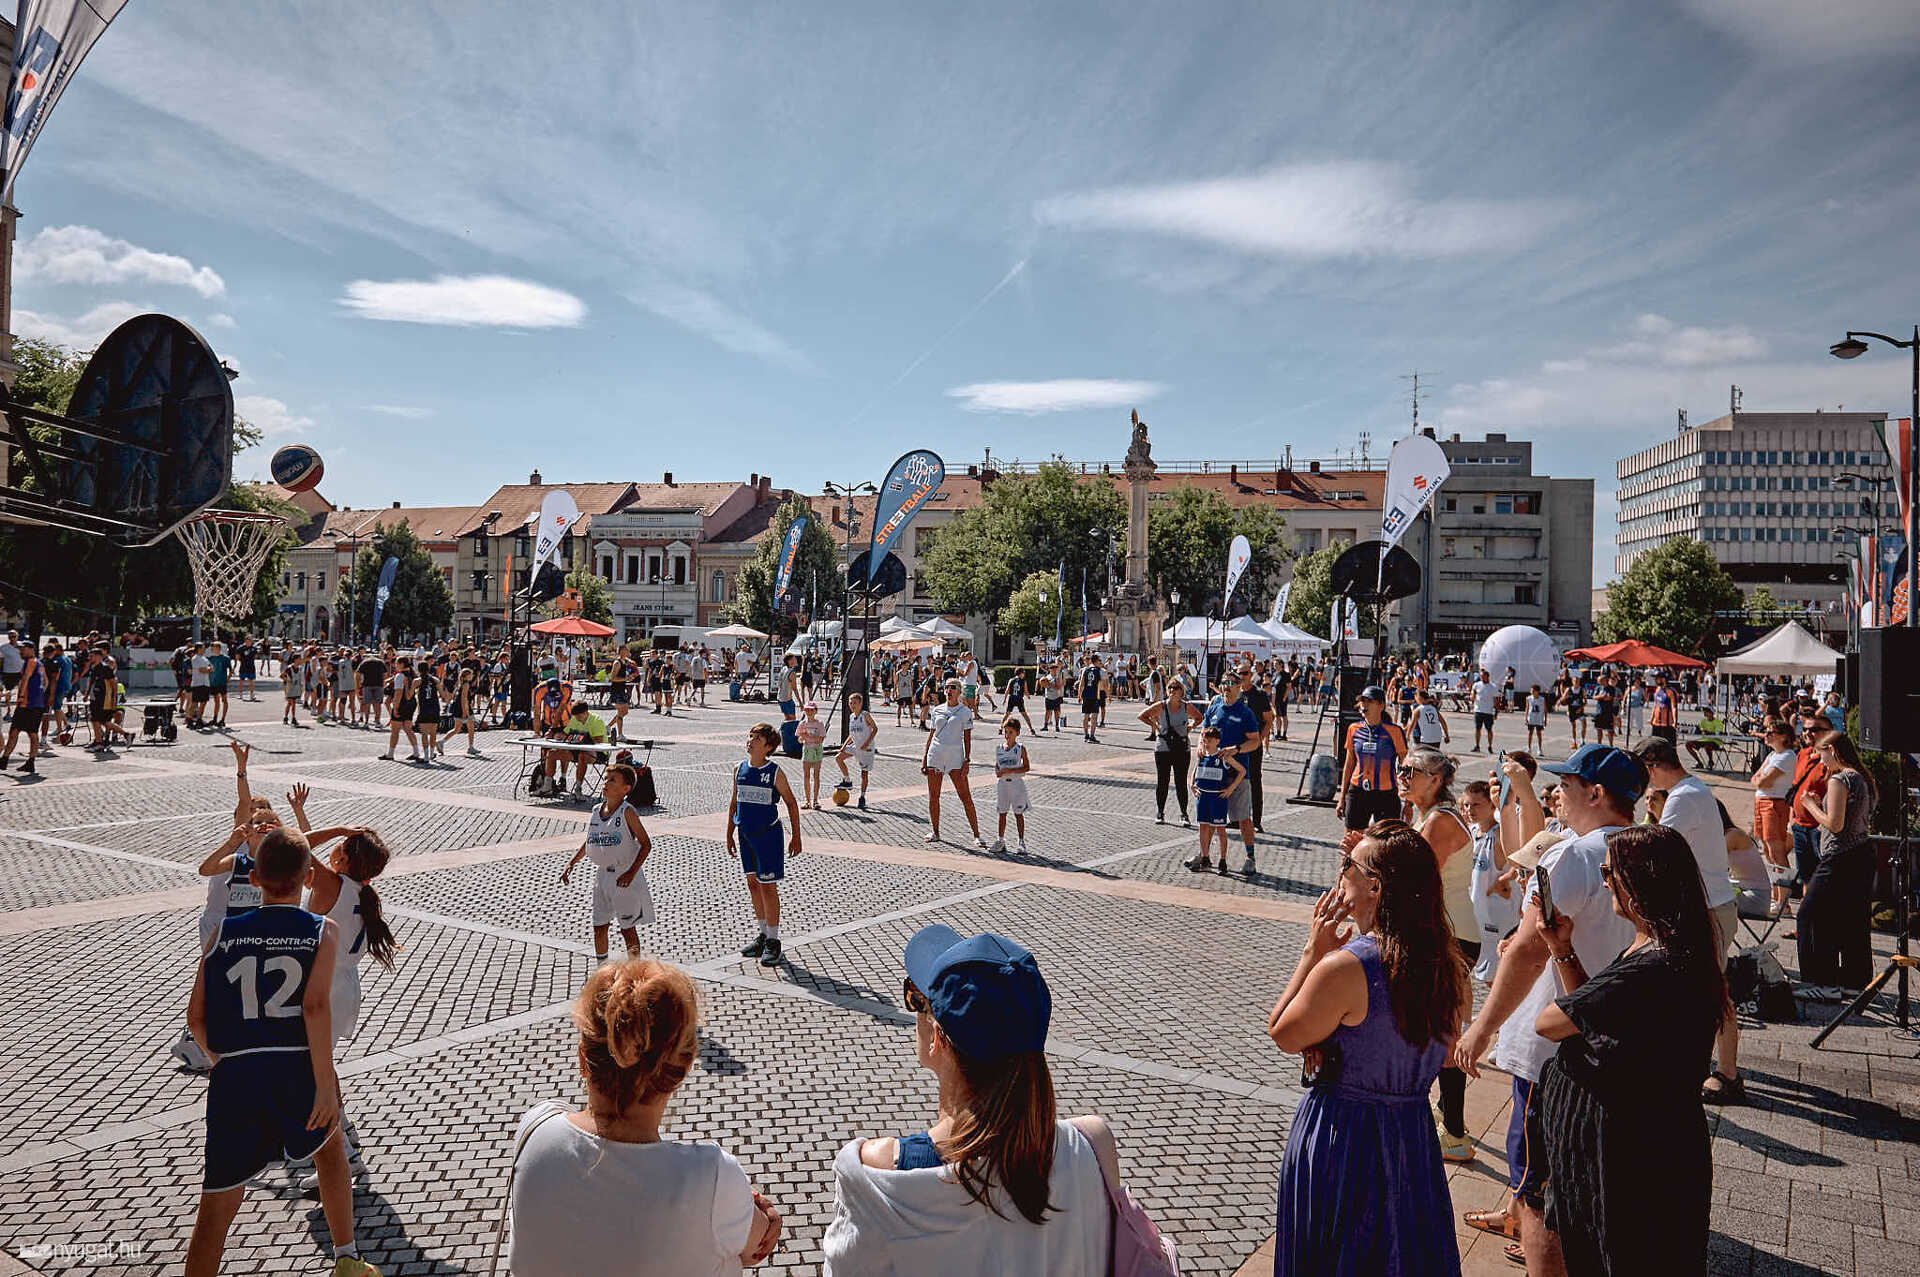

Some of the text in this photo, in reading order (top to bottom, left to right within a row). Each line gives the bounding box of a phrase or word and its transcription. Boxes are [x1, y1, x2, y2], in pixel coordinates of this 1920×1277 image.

[1424, 712, 1436, 725] 12
[759, 772, 770, 784] 14
[615, 816, 621, 828] 8
[236, 937, 318, 947] IMMO-CONTRACT
[226, 956, 303, 1019] 12
